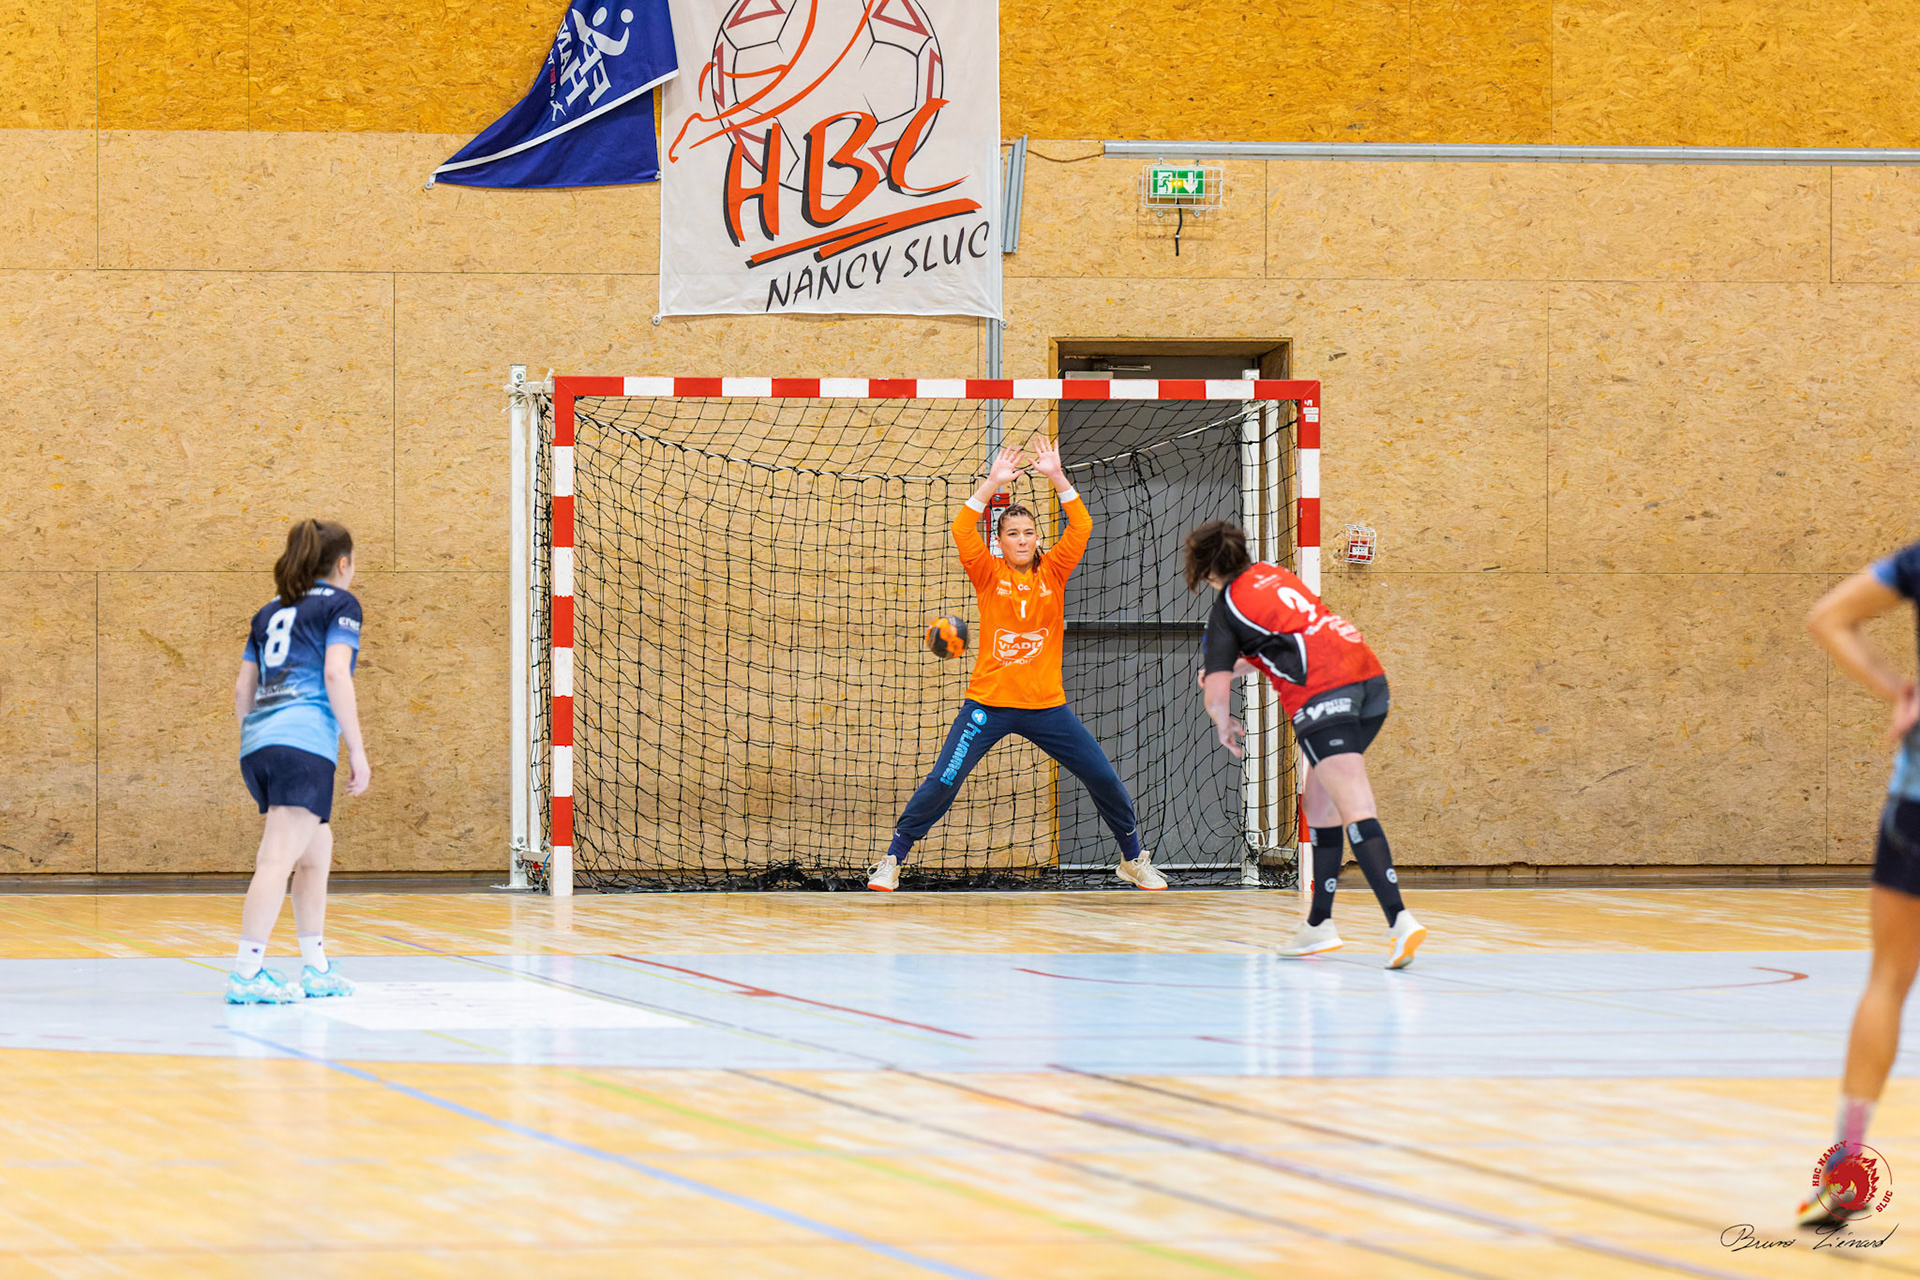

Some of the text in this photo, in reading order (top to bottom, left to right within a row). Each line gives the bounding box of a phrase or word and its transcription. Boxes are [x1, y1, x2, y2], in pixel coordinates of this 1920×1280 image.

[723, 97, 970, 247] HBC
[765, 221, 990, 312] NANCY SLUC
[264, 606, 298, 668] 8
[1020, 600, 1027, 618] 1
[939, 722, 982, 787] hummel
